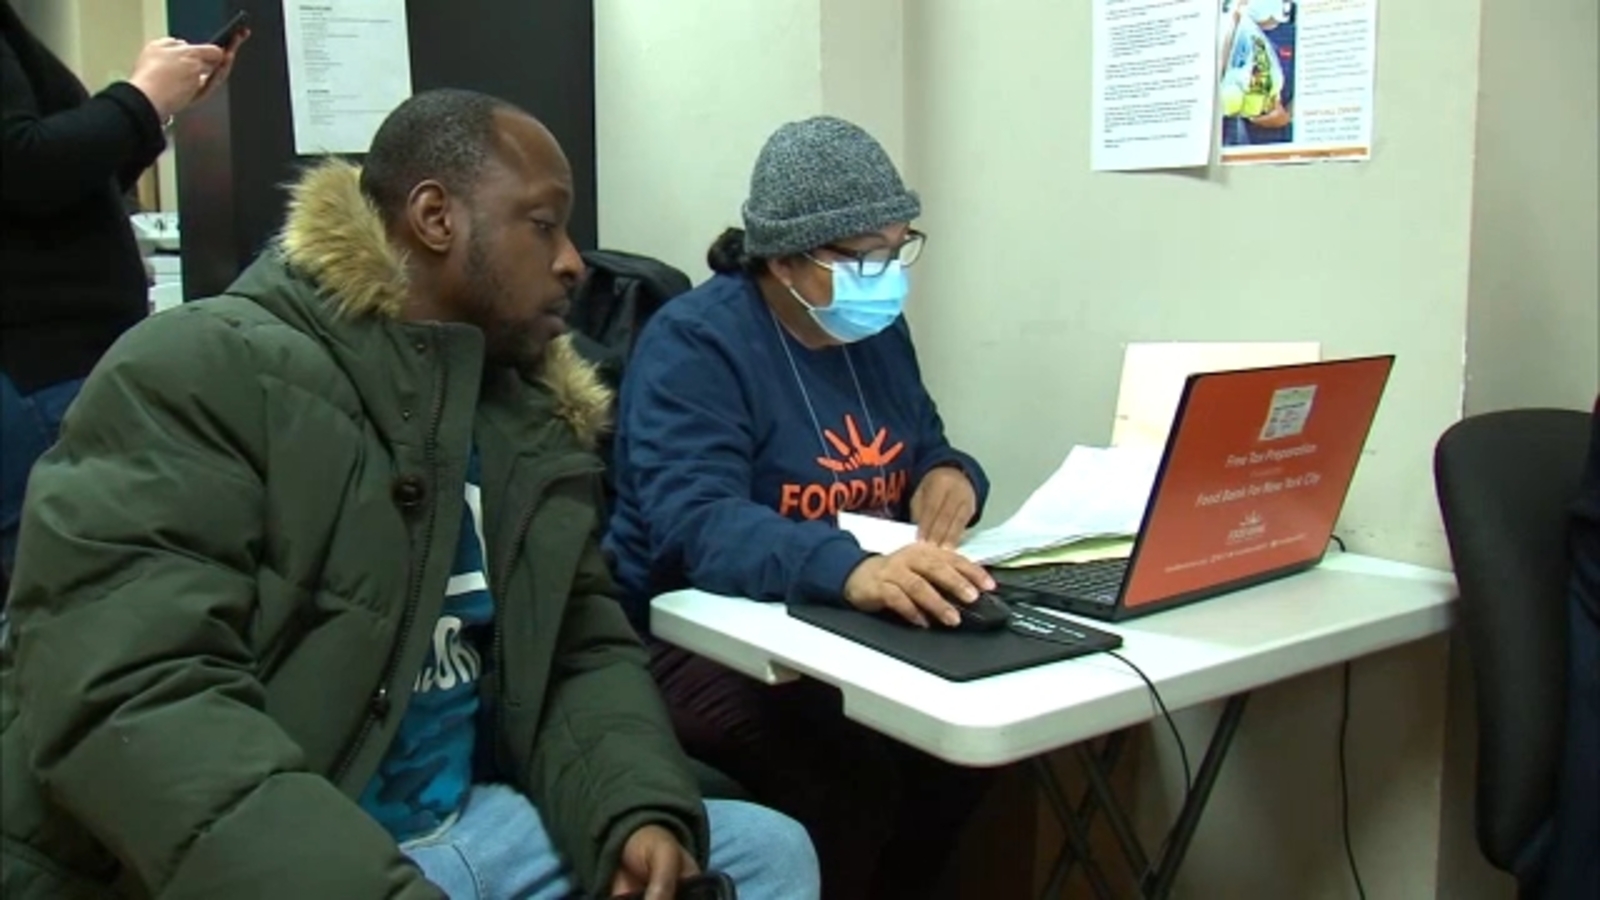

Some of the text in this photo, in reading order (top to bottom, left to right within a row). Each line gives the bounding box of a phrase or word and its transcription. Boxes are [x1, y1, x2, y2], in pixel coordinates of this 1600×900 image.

[1224, 444, 1317, 468] Free Tax Preparation
[780, 480, 868, 519] FOOD
[1195, 489, 1223, 508] Food
[1222, 485, 1246, 502] Bank
[1261, 481, 1283, 493] New
[1285, 475, 1303, 489] York
[1303, 471, 1321, 487] City
